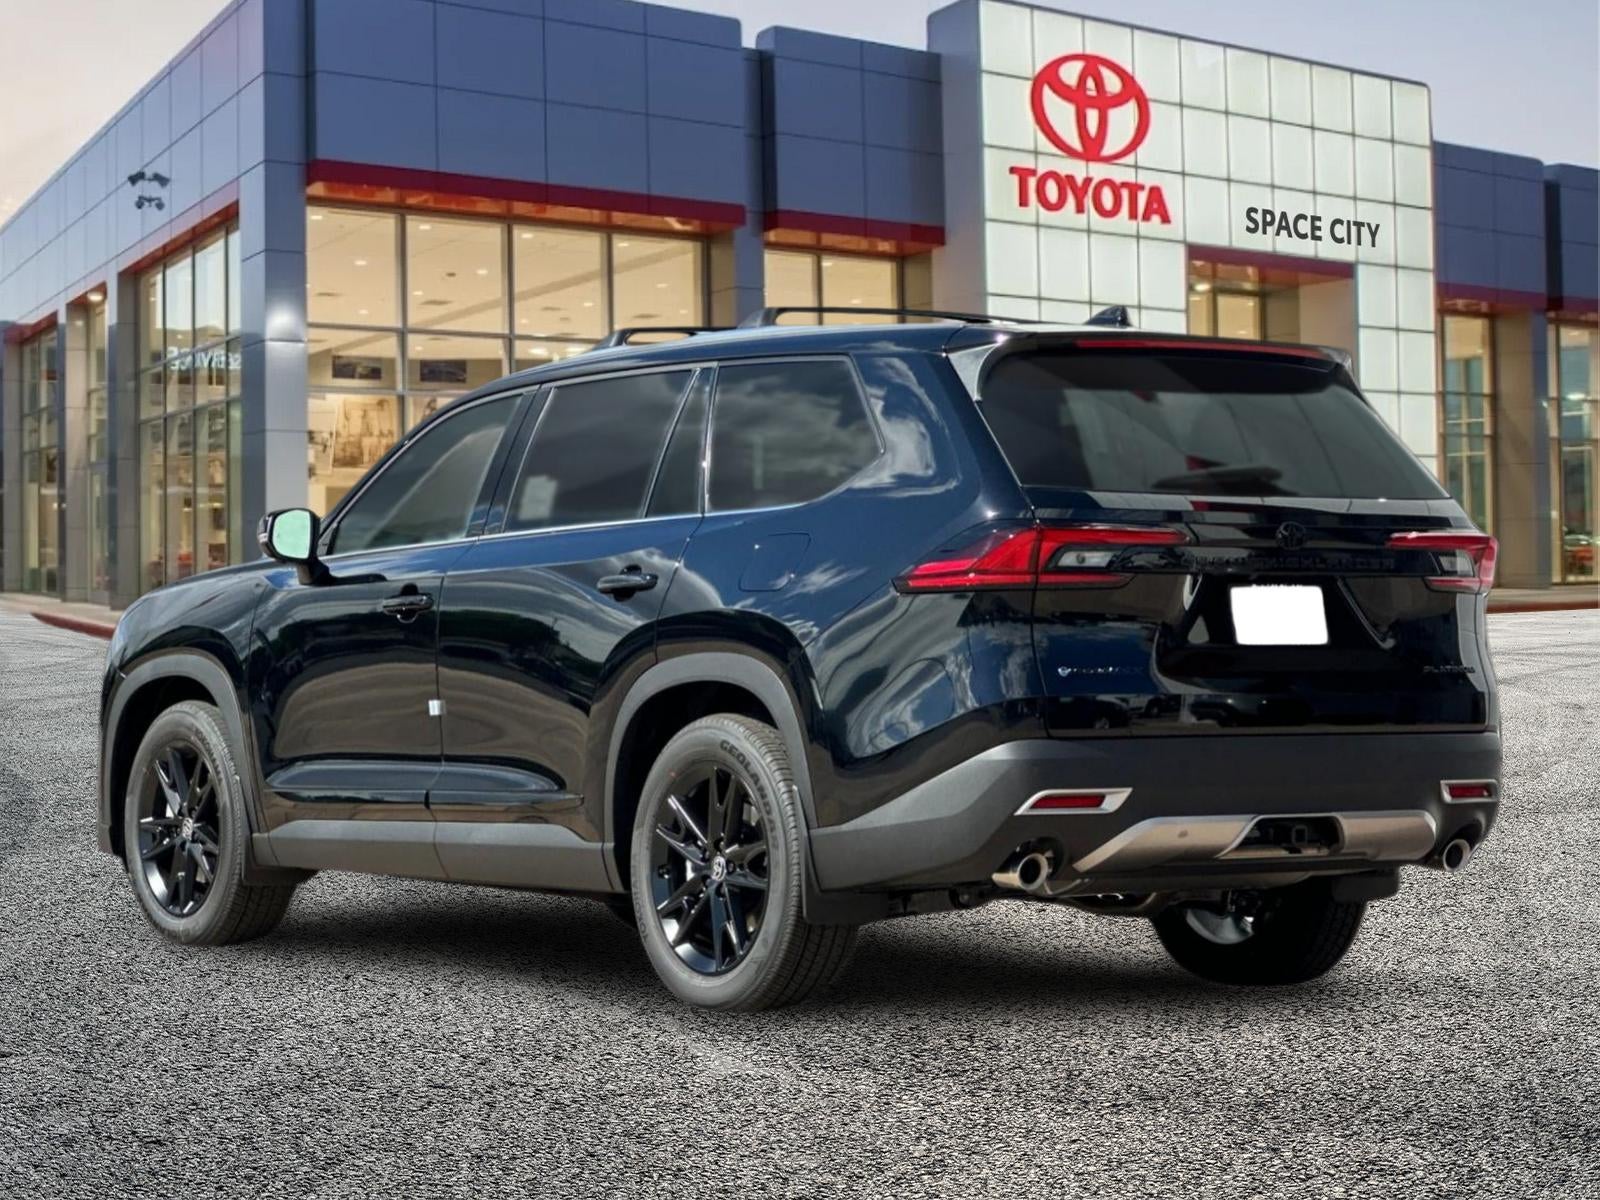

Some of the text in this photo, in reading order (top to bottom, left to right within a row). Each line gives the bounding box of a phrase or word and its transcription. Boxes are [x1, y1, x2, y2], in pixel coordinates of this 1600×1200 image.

[1009, 166, 1171, 225] TOYOTA
[1245, 206, 1381, 248] SPACE CITY
